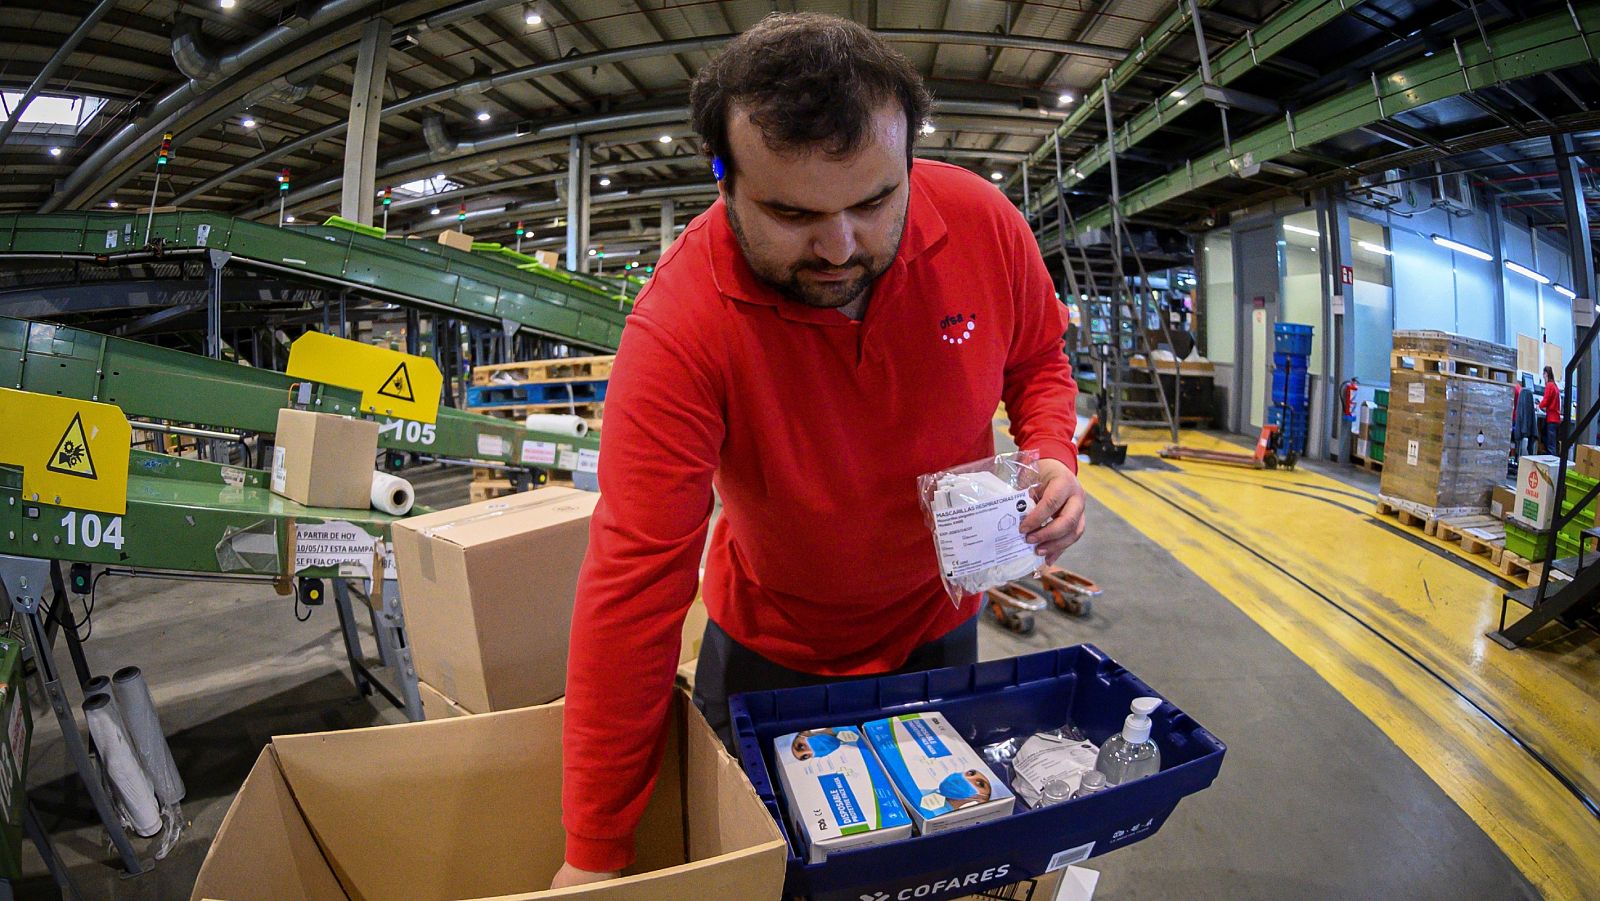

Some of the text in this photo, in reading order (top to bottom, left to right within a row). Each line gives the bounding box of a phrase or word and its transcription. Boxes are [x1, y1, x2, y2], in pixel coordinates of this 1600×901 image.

[392, 418, 437, 446] 105
[936, 506, 975, 518] MASCARILLAS
[61, 511, 125, 550] 104
[341, 532, 356, 540] HOY
[297, 545, 374, 553] 10/05/17 ESTA RAMPA
[296, 557, 305, 566] SE
[830, 789, 852, 824] DISPOSABLE
[897, 864, 1010, 901] COFARES
